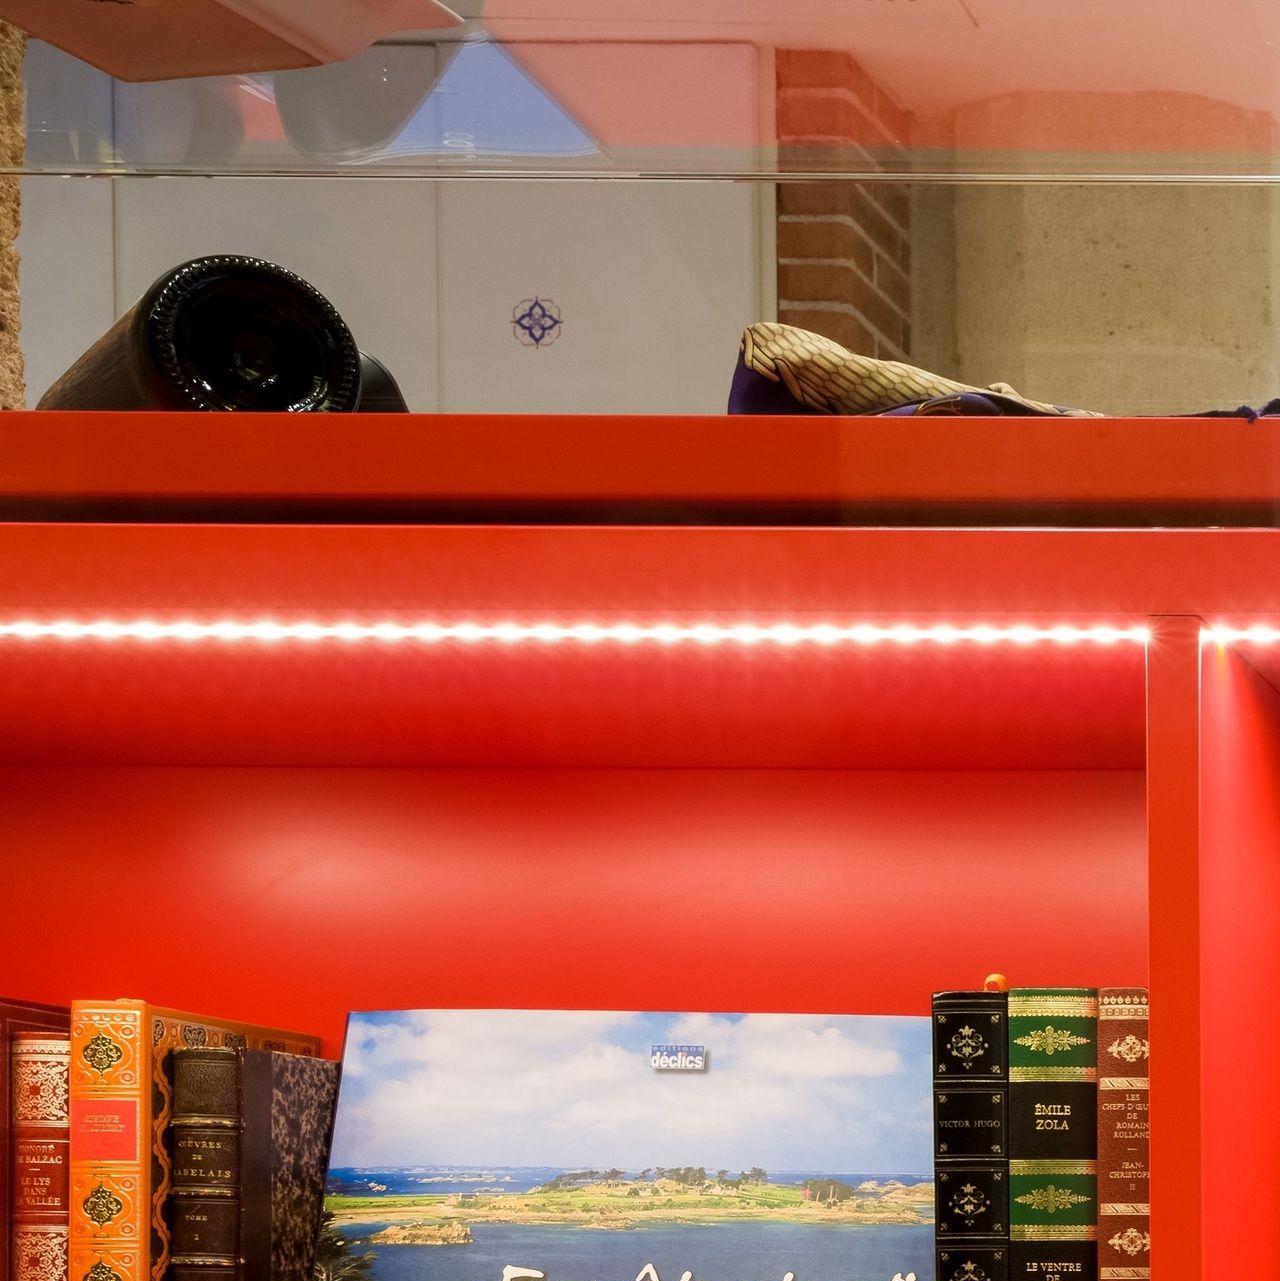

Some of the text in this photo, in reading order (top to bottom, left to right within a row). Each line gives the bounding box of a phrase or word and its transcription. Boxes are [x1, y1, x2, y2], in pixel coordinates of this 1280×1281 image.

[651, 1051, 704, 1069] déclics
[1034, 1103, 1071, 1116] ÉMILE
[939, 1120, 1001, 1129] VICTOR HUGO
[1036, 1119, 1070, 1131] ZOLA
[25, 1155, 63, 1165] BALZAC
[1026, 1262, 1082, 1272] LE VENTRE
